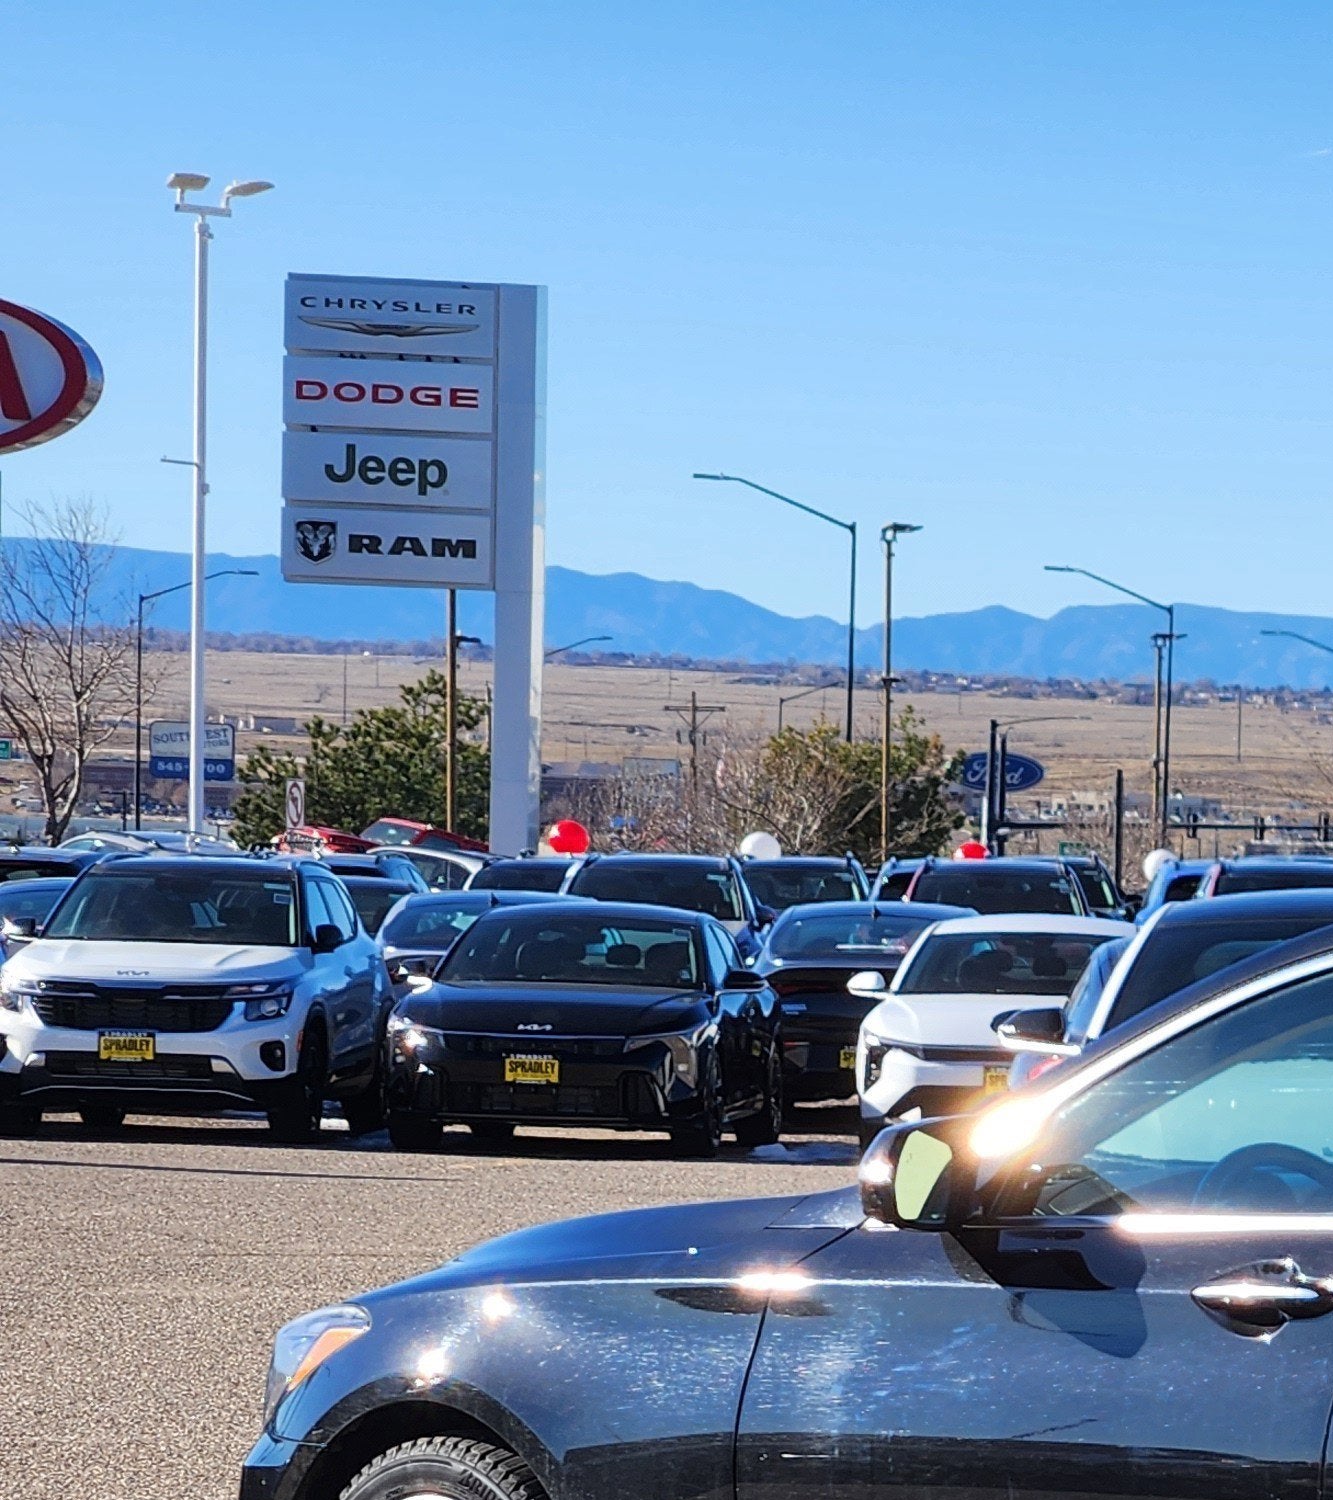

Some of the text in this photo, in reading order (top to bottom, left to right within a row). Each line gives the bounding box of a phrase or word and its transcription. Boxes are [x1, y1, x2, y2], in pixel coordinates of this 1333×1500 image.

[300, 296, 477, 315] CHRYSLER
[295, 380, 479, 408] DODGE
[324, 443, 448, 496] Jeep
[348, 534, 477, 559] RAM
[153, 728, 229, 744] SOUTEST
[103, 1038, 151, 1051] SPRADLEY
[508, 1060, 556, 1074] SPRADLEY
